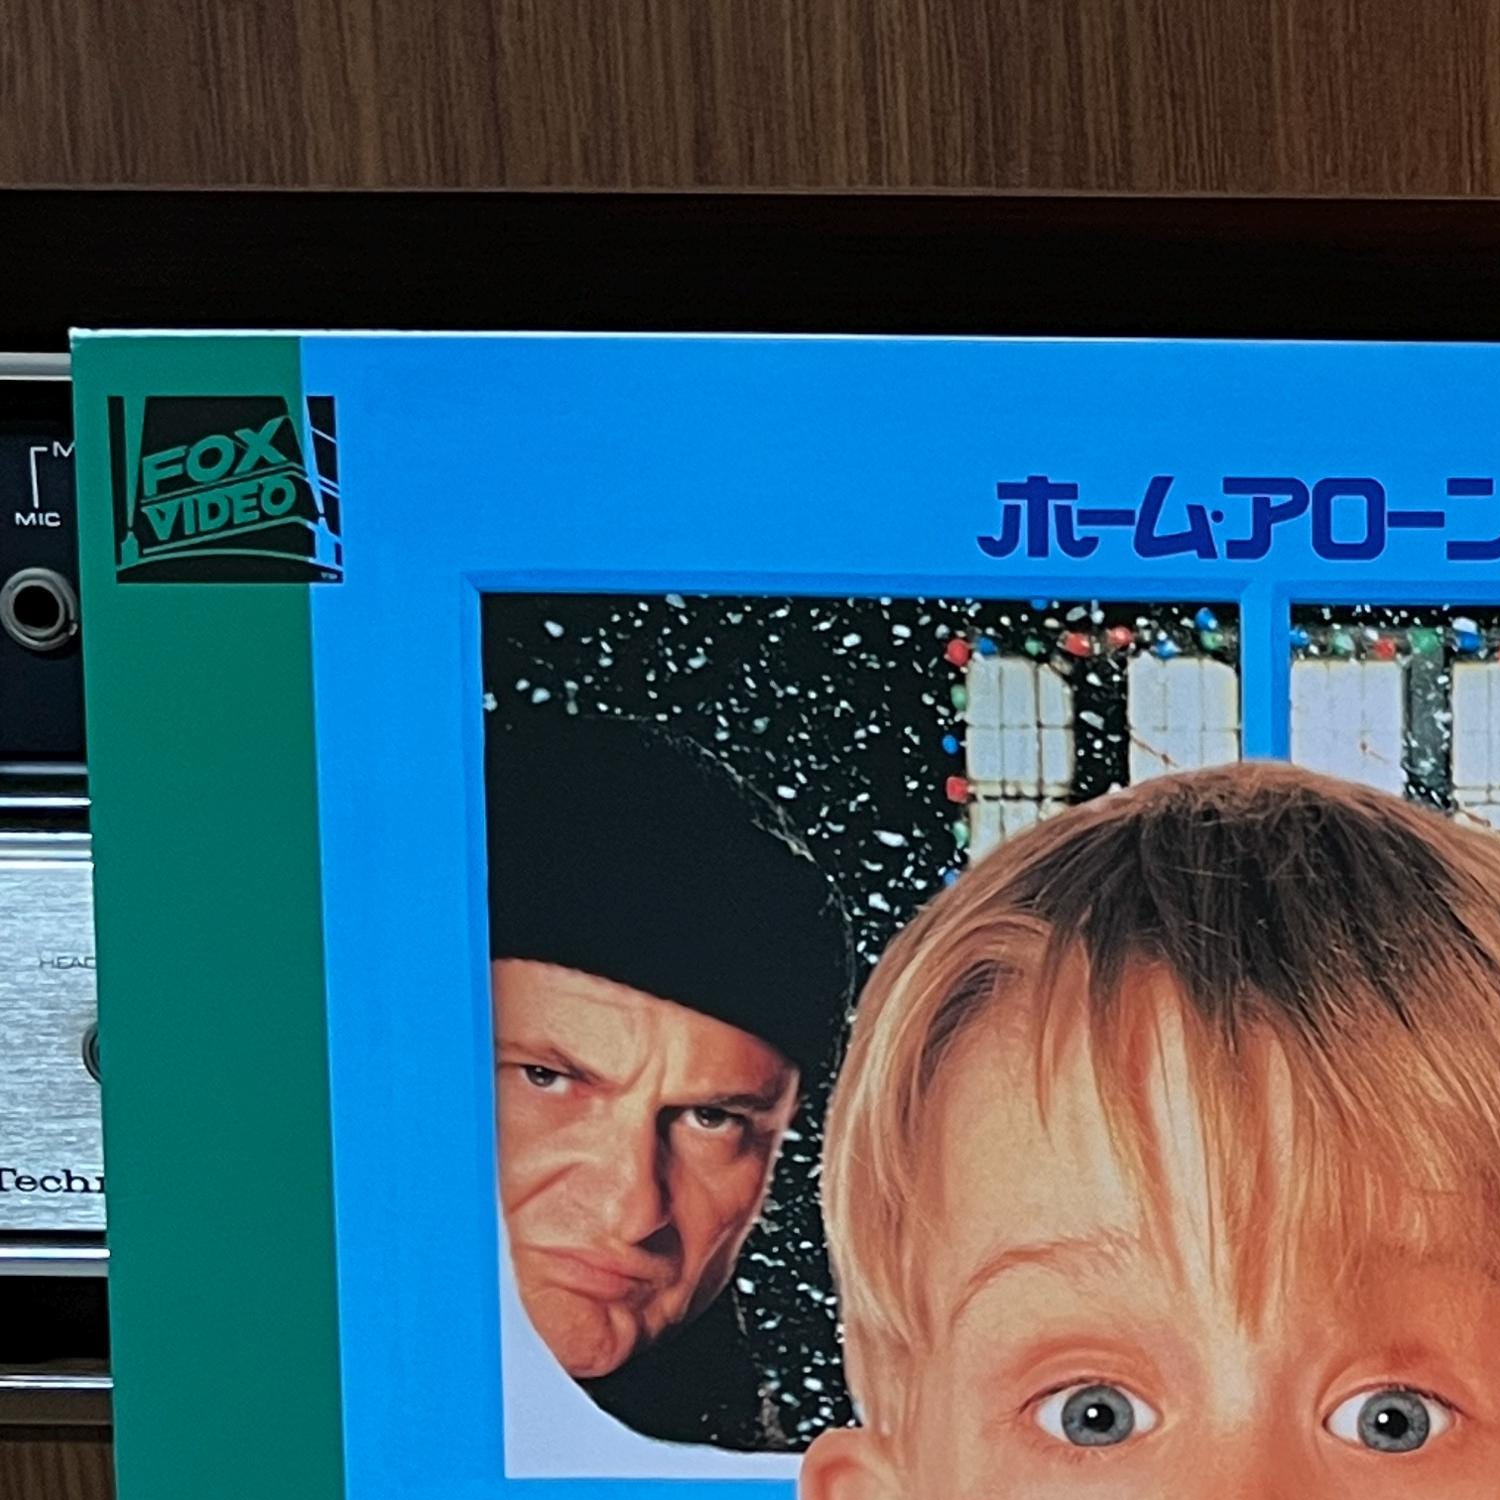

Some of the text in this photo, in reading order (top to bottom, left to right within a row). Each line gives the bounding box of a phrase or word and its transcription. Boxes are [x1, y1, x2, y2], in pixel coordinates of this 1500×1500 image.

[141, 414, 289, 497] FOX
[15, 512, 62, 528] MIC
[141, 474, 297, 541] VIDEO
